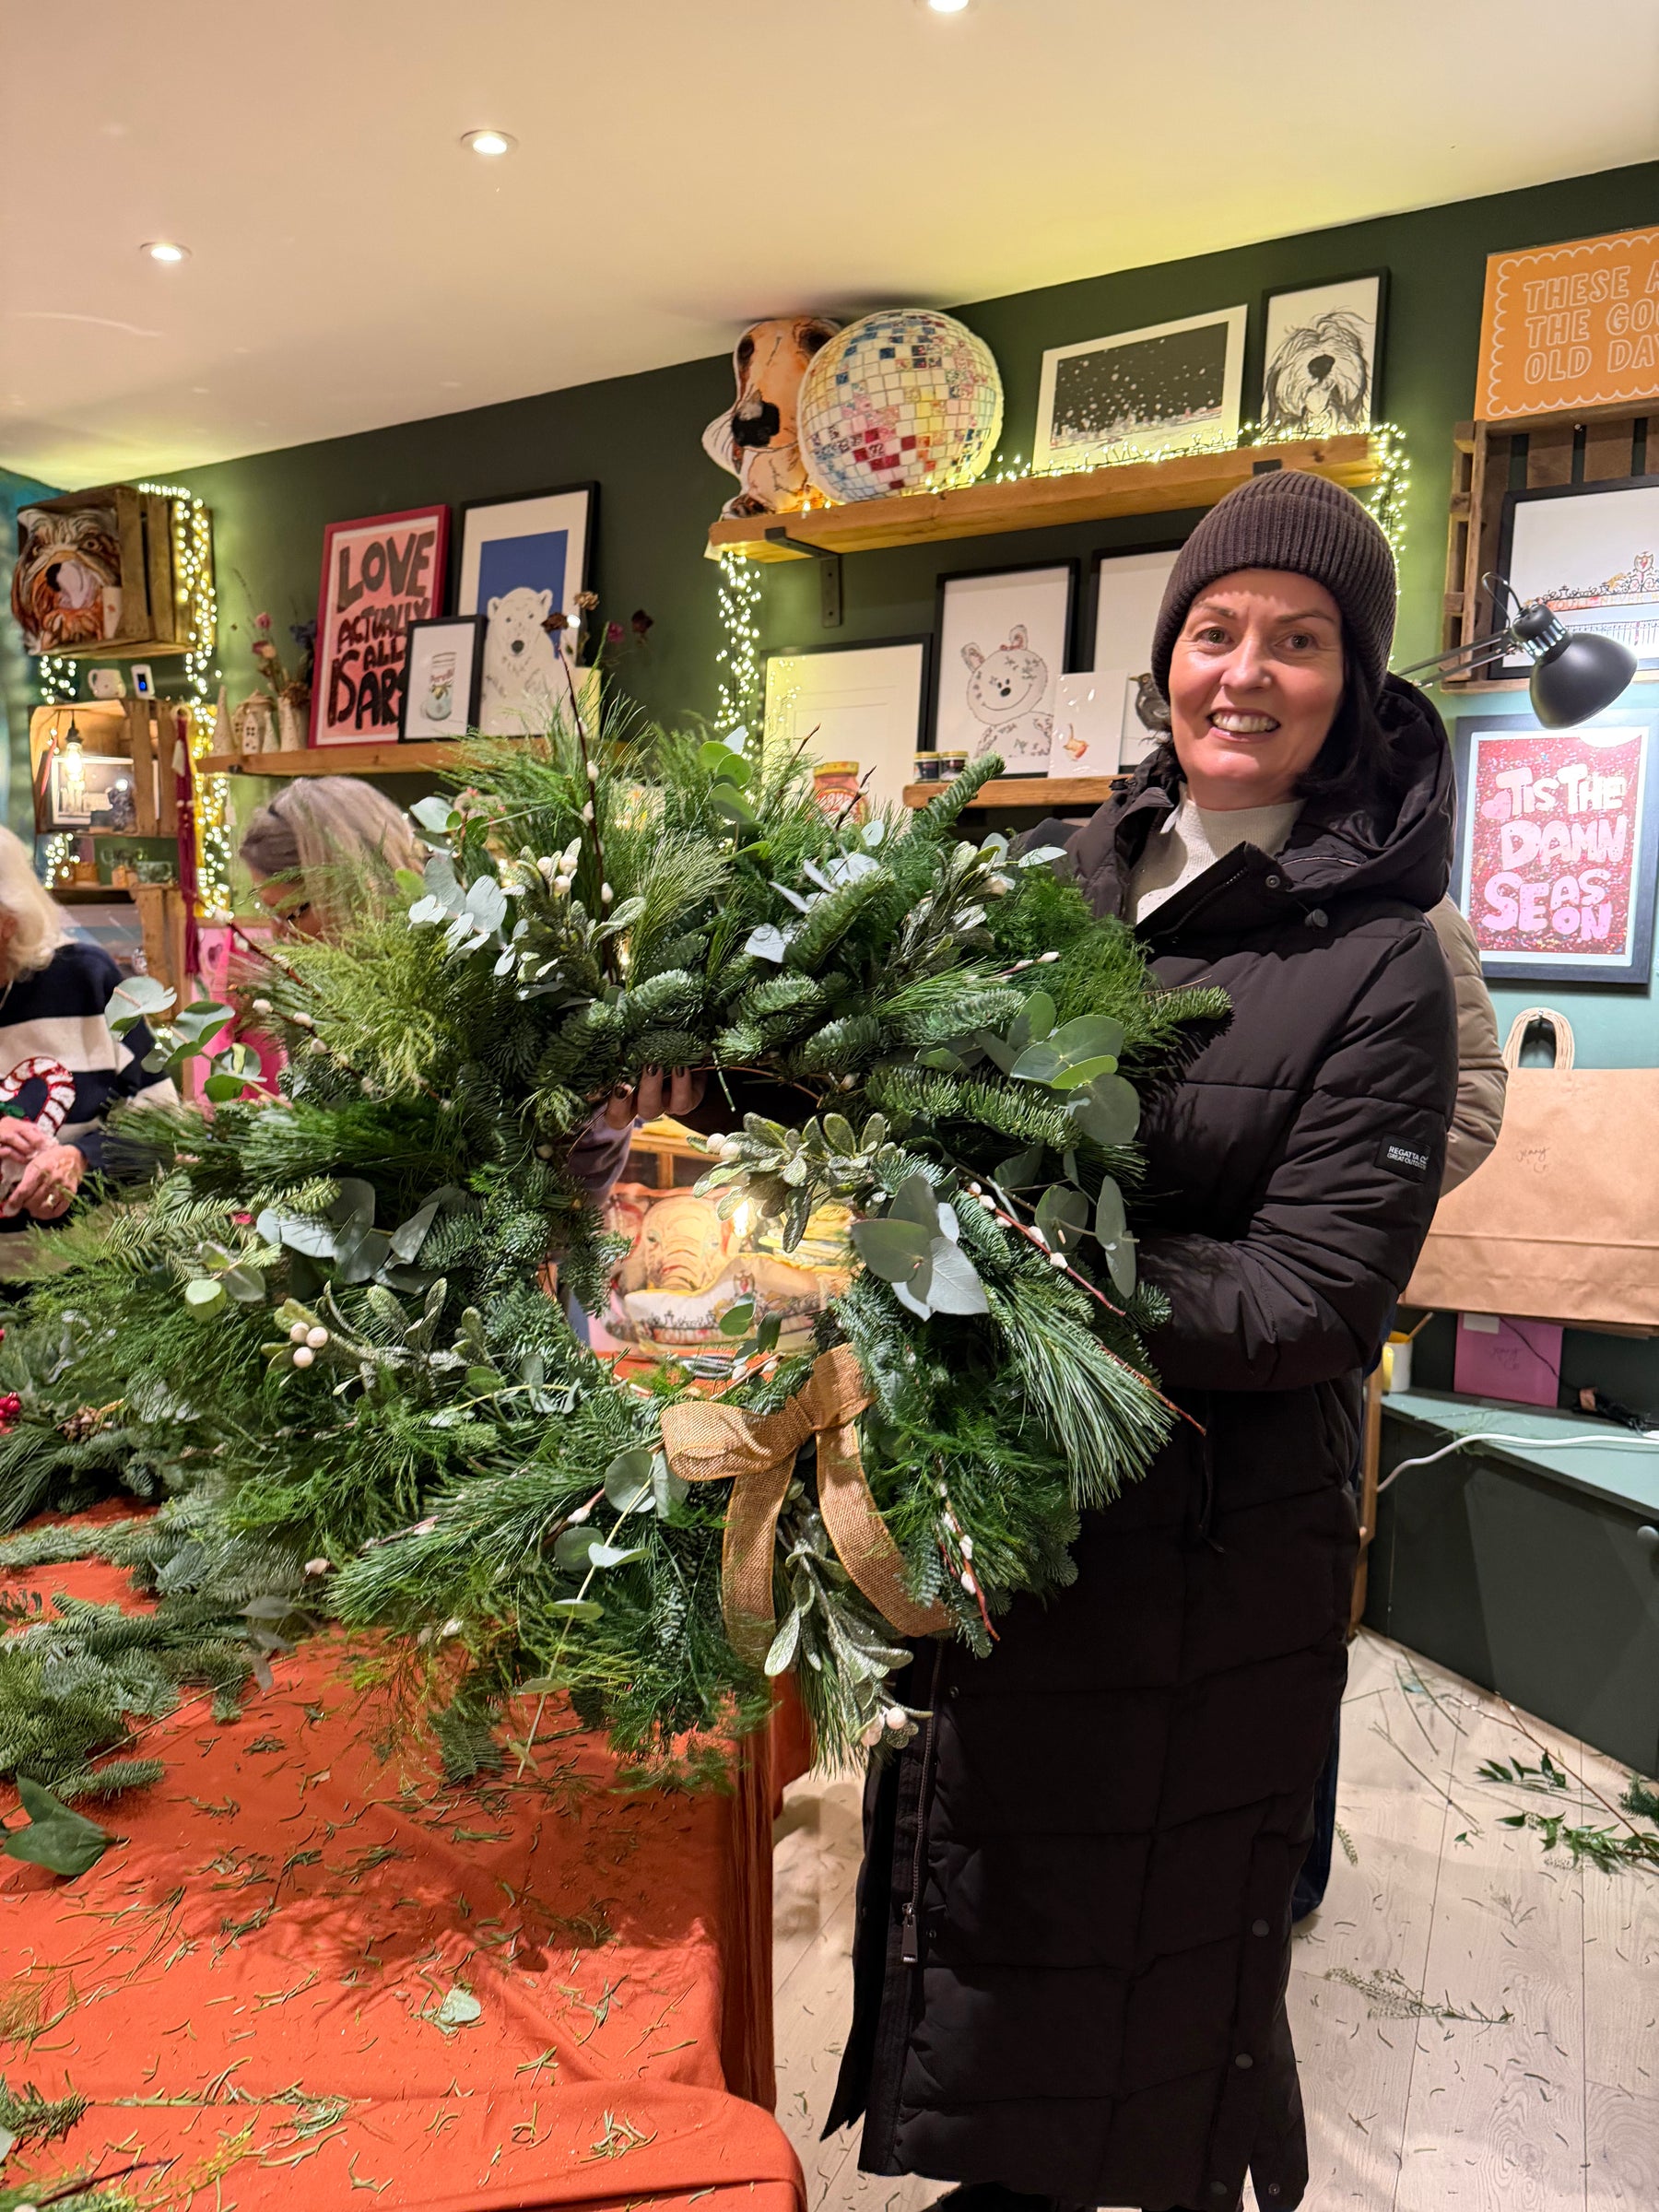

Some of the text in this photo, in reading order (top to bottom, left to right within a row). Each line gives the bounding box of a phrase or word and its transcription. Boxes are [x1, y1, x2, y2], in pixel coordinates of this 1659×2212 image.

[1524, 265, 1630, 313] THESE
[1525, 298, 1659, 348] THE GO
[1524, 335, 1659, 384] OLD DA
[337, 530, 435, 614] LOVE
[364, 637, 406, 672] ALL
[1496, 763, 1627, 816] TIS THE
[1500, 814, 1628, 870] DAMN
[1388, 1146, 1419, 1161] REGATTA
